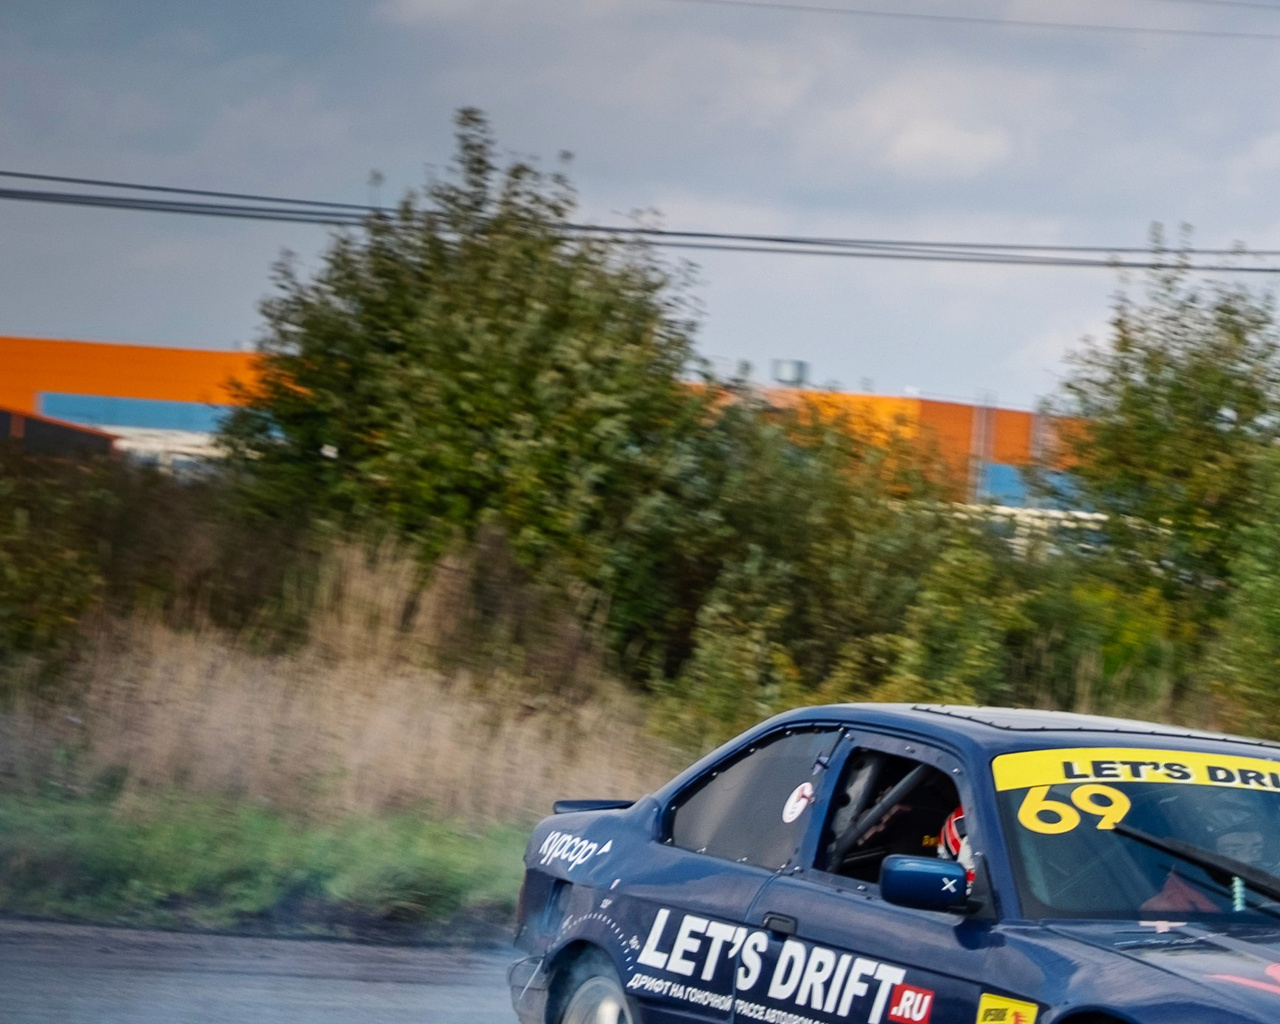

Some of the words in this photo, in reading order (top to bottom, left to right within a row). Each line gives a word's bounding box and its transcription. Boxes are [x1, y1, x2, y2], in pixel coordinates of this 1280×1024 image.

[1062, 760, 1193, 781] LET'S
[1017, 783, 1132, 835] 69
[538, 831, 598, 872] курсор
[636, 908, 768, 991] LET'S
[626, 972, 671, 997] ДРИФТ
[670, 984, 685, 1000] НА
